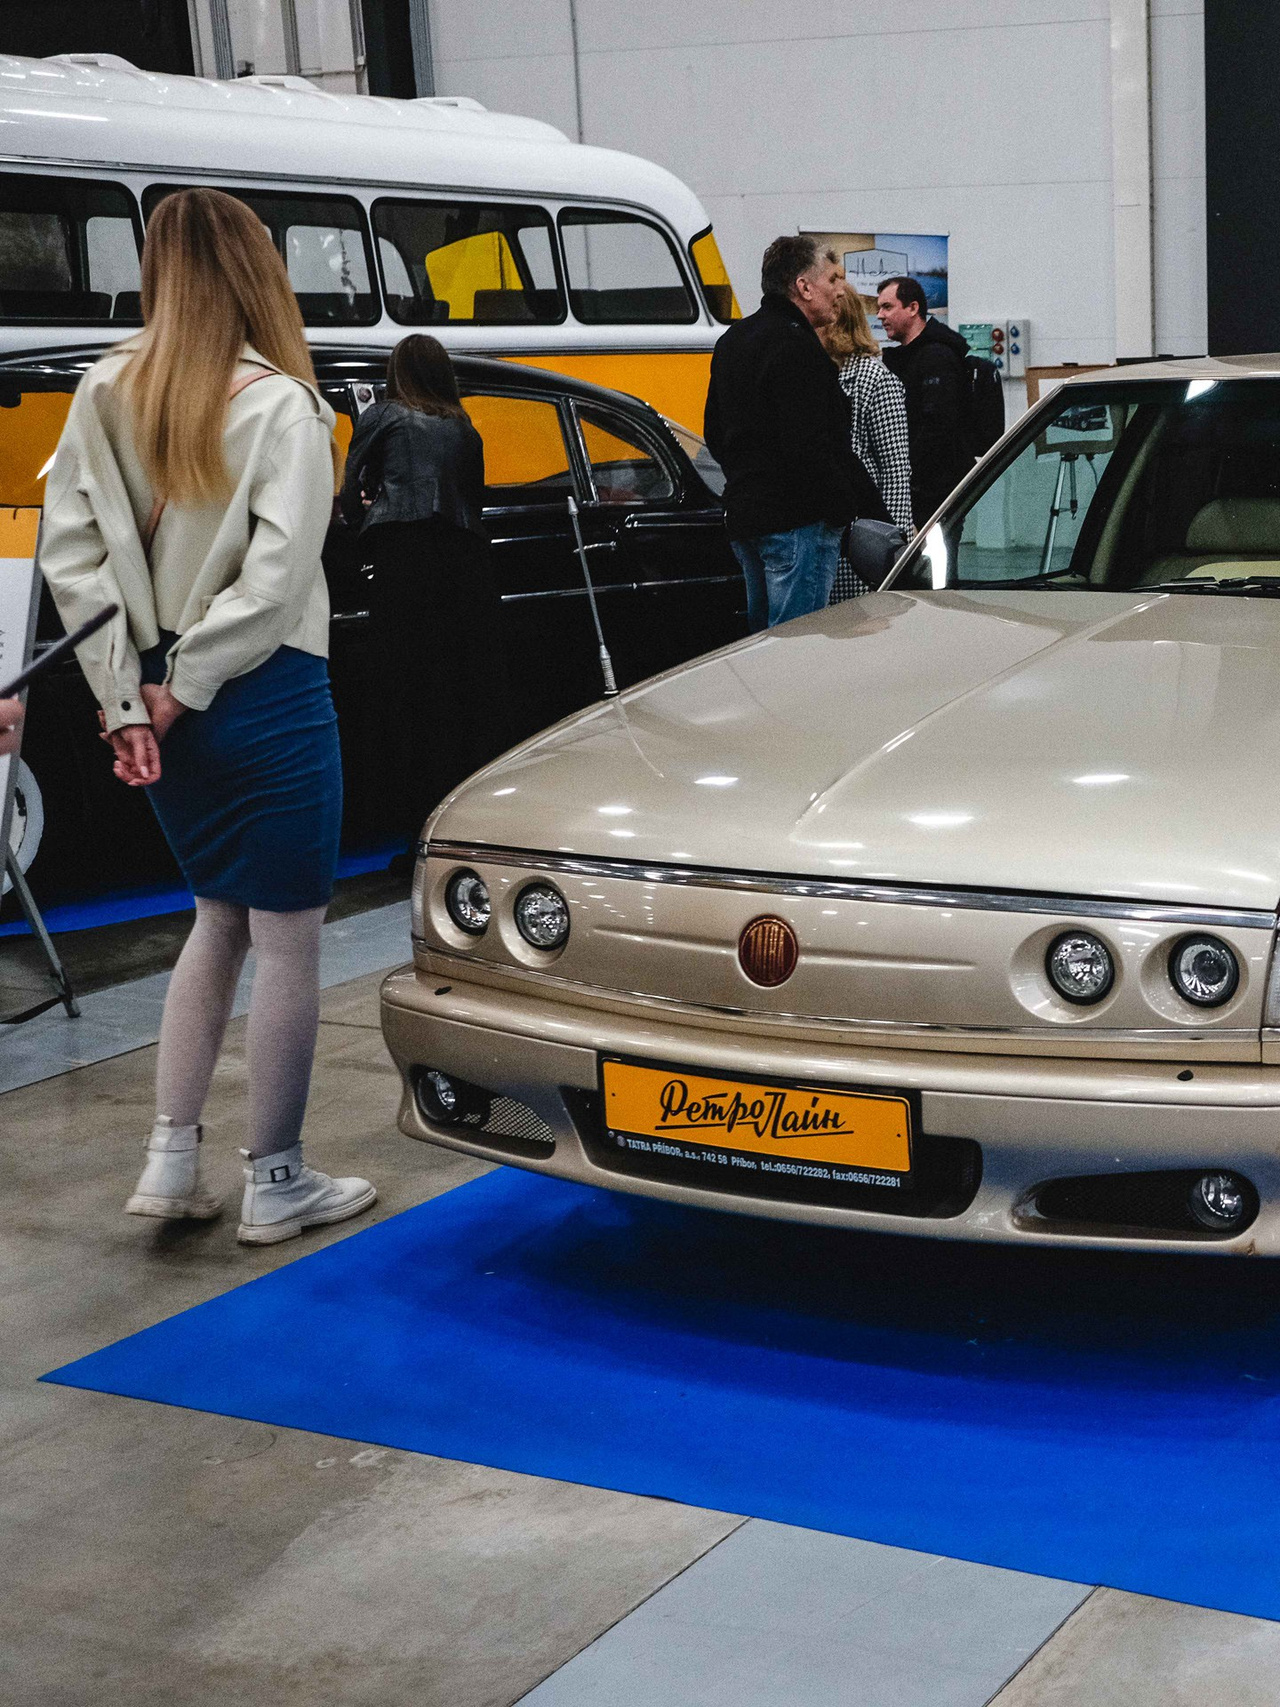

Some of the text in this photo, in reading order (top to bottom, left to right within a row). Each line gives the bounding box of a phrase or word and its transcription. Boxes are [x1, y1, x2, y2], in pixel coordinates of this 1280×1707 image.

[627, 1139, 651, 1152] TATRA
[702, 1152, 716, 1163] 742
[718, 1154, 728, 1165] 58
[832, 1170, 901, 1188] fax:0656/722281
